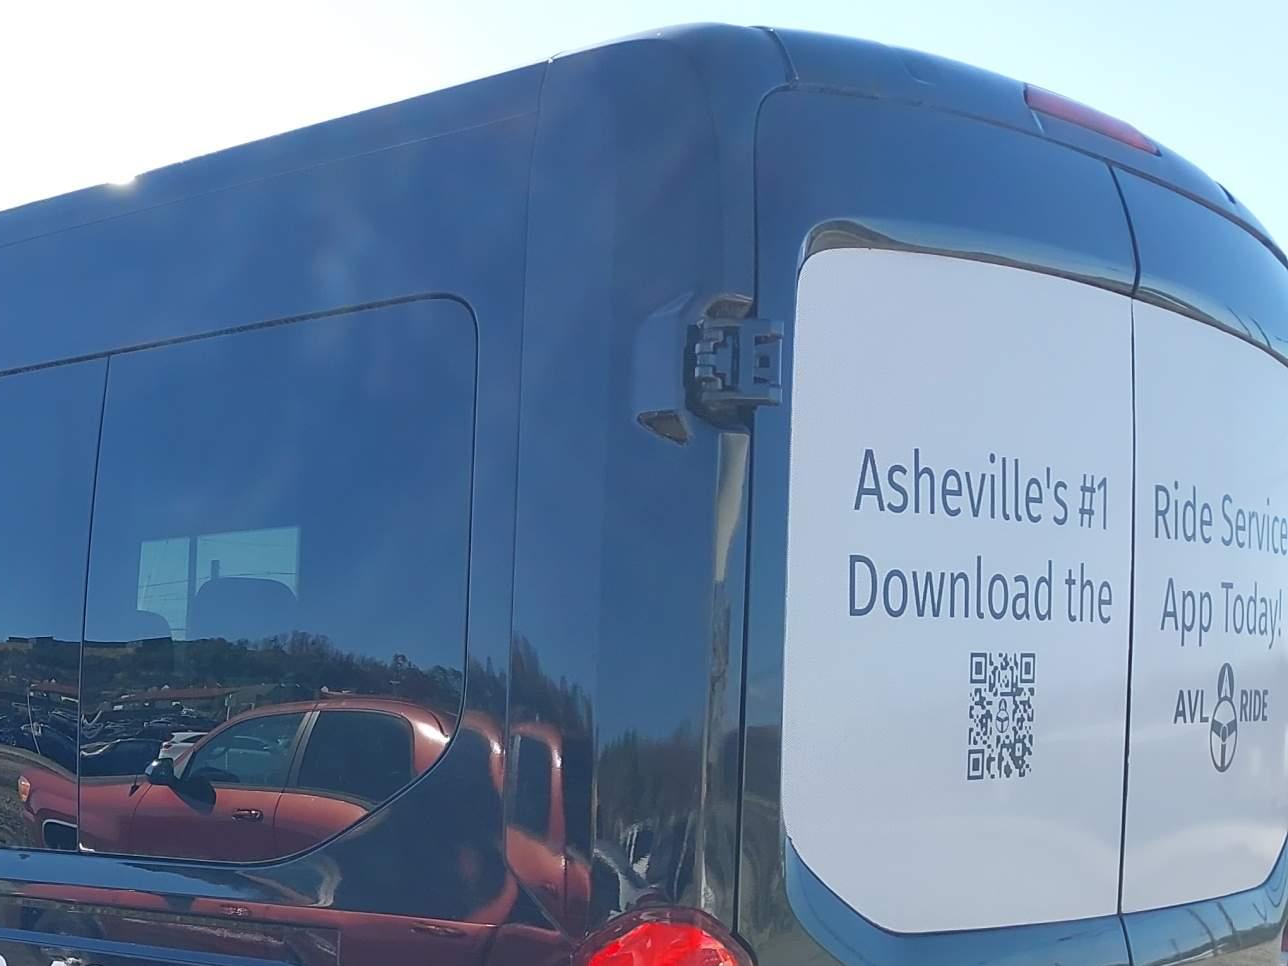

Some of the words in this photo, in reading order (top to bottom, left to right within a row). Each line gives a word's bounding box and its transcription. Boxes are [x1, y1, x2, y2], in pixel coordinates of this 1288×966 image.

[853, 448, 1069, 527] Asheville's
[1078, 473, 1109, 530] #1
[1154, 480, 1213, 544] Ride
[1221, 494, 1288, 556] Service
[848, 554, 1053, 622] Download
[1065, 563, 1113, 624] the
[1160, 577, 1212, 648] App
[1220, 581, 1283, 650] Today!
[1173, 689, 1210, 725] AVL
[1239, 689, 1269, 723] RIDE
